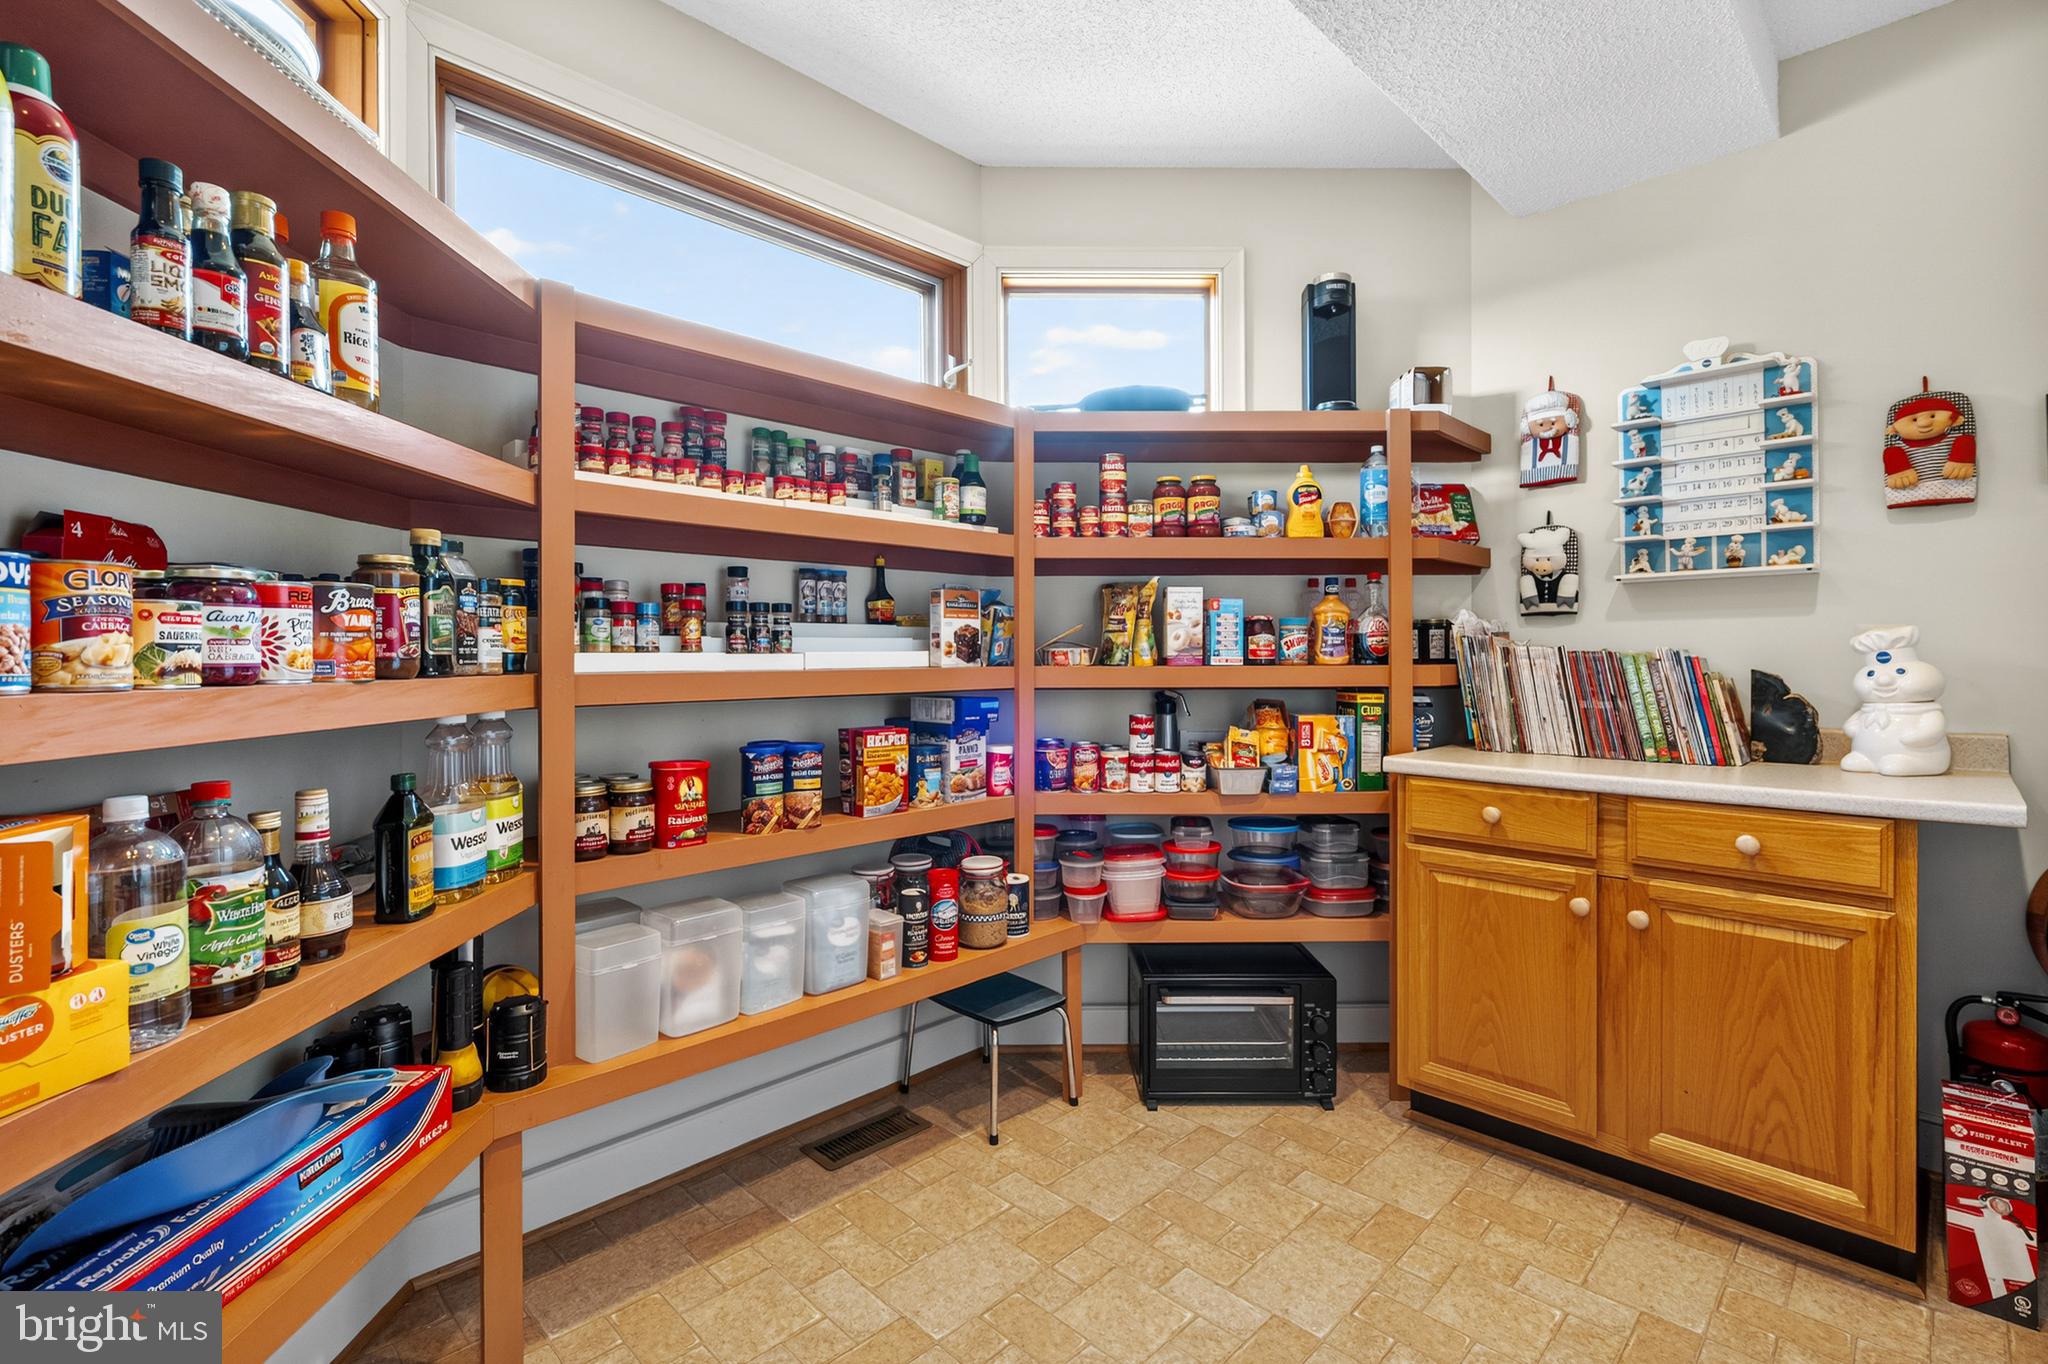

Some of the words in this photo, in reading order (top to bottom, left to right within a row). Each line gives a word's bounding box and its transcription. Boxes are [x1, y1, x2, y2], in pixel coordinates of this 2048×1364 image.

[30, 183, 70, 219] DU
[31, 211, 69, 254] FA
[150, 260, 182, 279] LIQ
[342, 330, 369, 349] Rice
[206, 609, 245, 622] Aunt
[866, 733, 907, 748] HELPER
[451, 830, 488, 851] Wesso
[8, 921, 25, 984] DUSTERS
[136, 944, 180, 961] Vinegar
[152, 938, 180, 951] White
[200, 936, 236, 952] Apple
[0, 1023, 44, 1046] USTER
[1969, 1130, 1996, 1142] FIRST
[1997, 1137, 2029, 1149] ALERT
[76, 1235, 157, 1288] Reynolds
[192, 1238, 226, 1266] Quality
